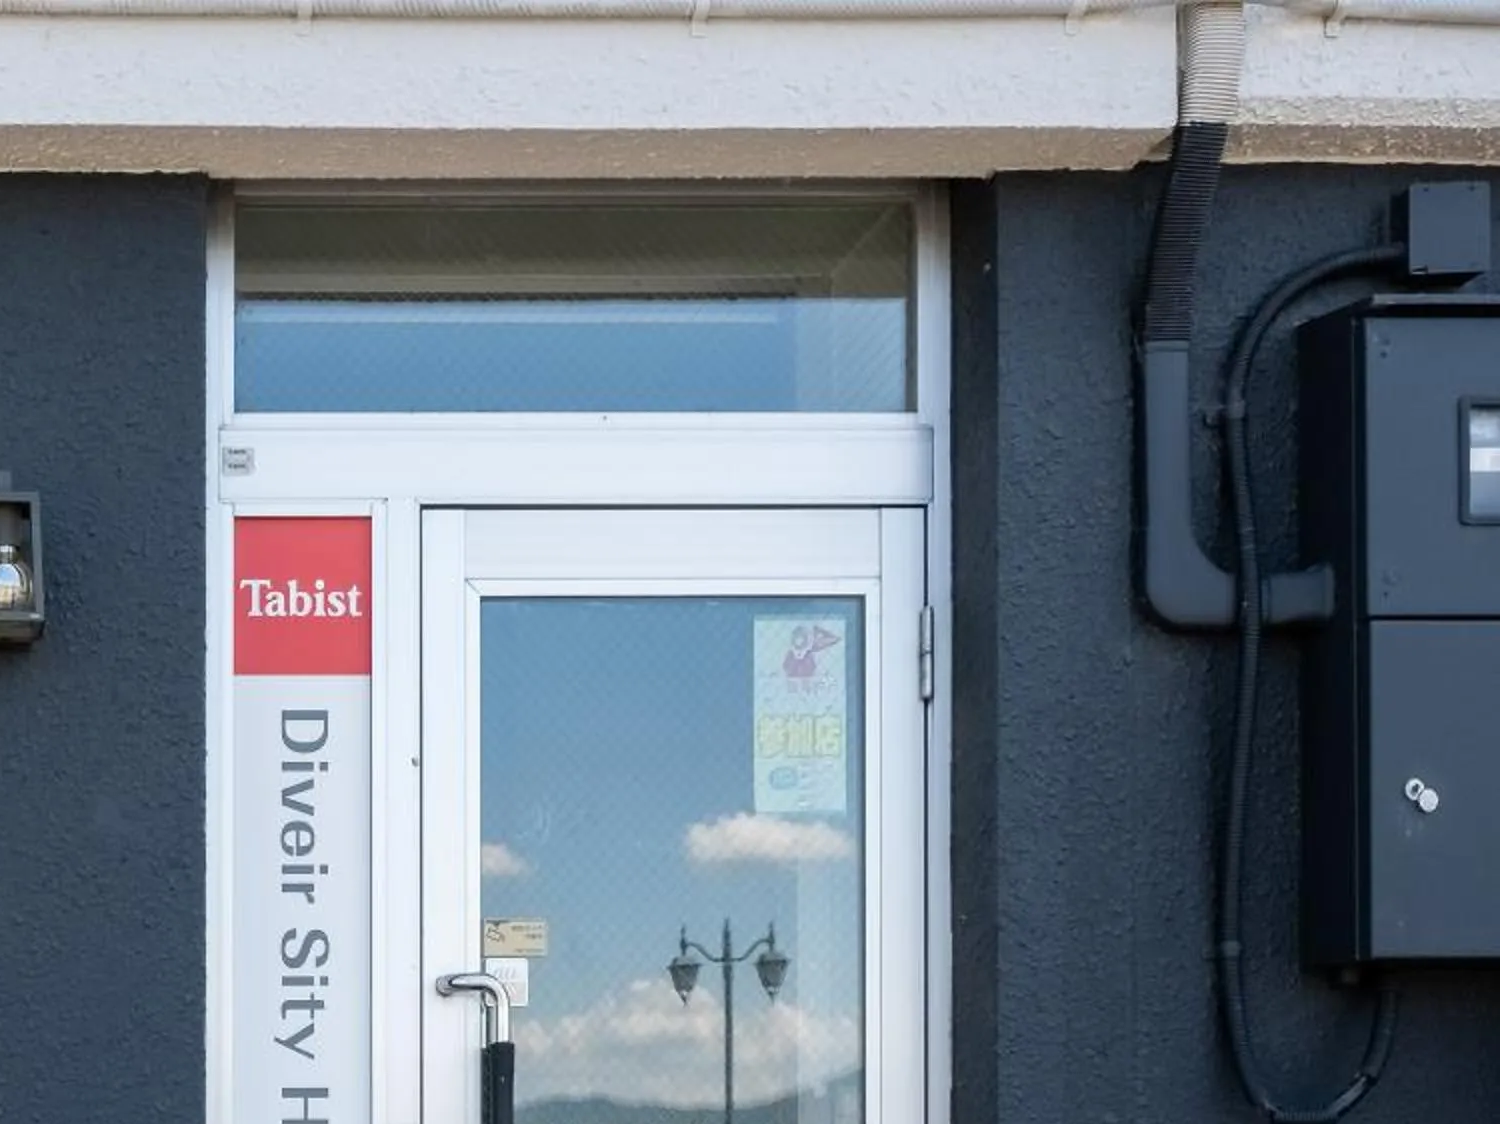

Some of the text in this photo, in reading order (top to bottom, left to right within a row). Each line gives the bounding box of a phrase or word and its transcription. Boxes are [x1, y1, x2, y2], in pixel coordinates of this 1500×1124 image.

[239, 579, 363, 618] Tabist
[280, 709, 329, 905] Diveir
[273, 927, 330, 1061] Sity
